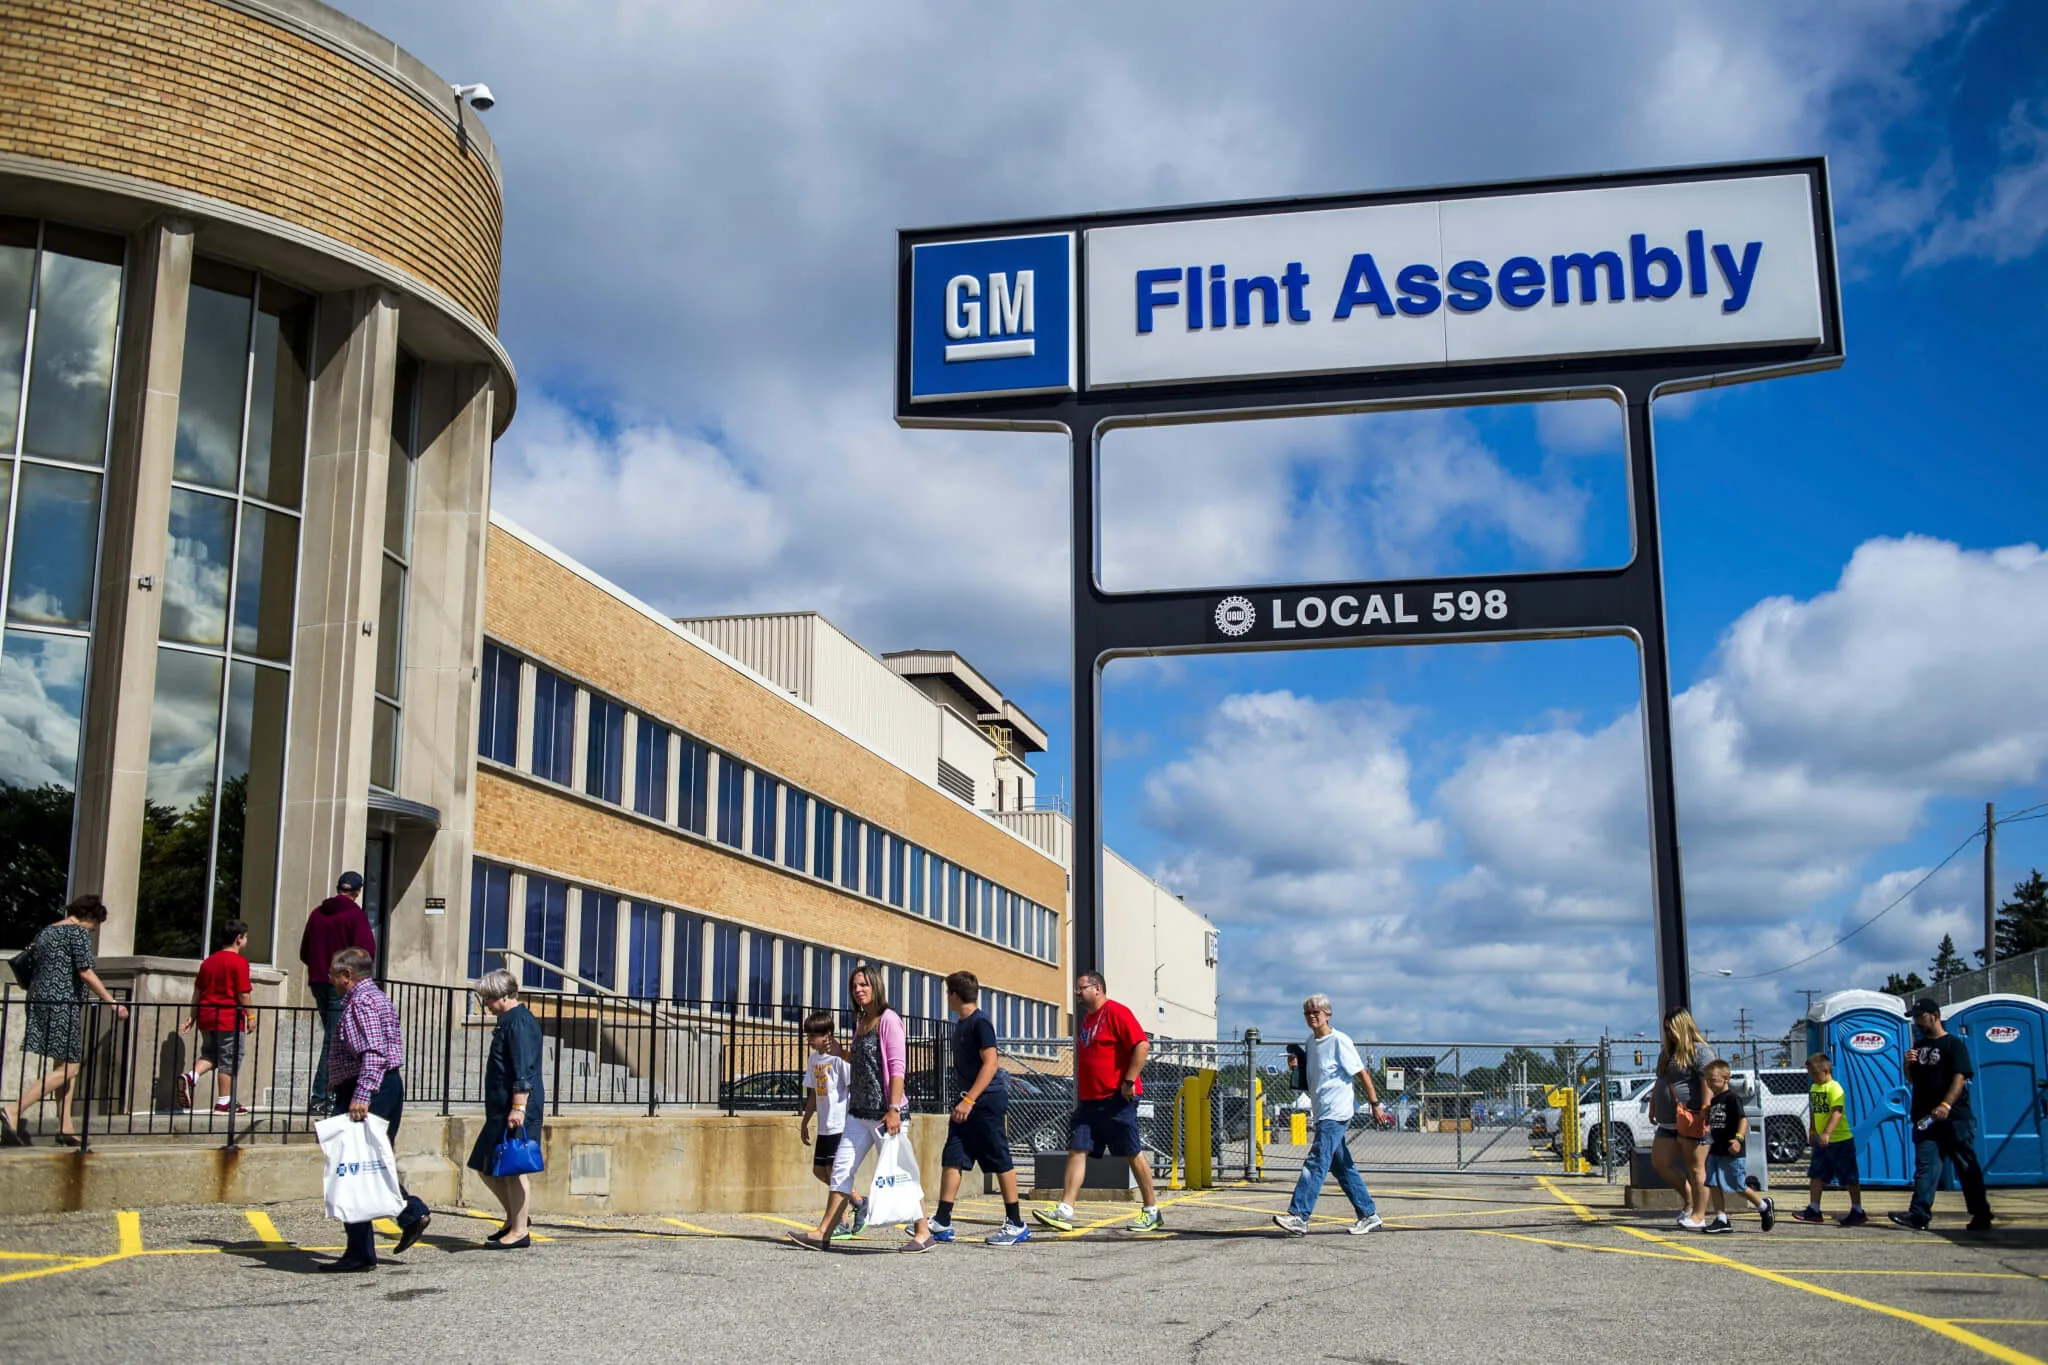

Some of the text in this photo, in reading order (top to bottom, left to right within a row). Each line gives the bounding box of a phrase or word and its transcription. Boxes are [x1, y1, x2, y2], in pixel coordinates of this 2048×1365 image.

[946, 270, 1034, 339] GM
[1137, 229, 1762, 333] Flint Assembly
[1272, 589, 1508, 629] LOCAL 598
